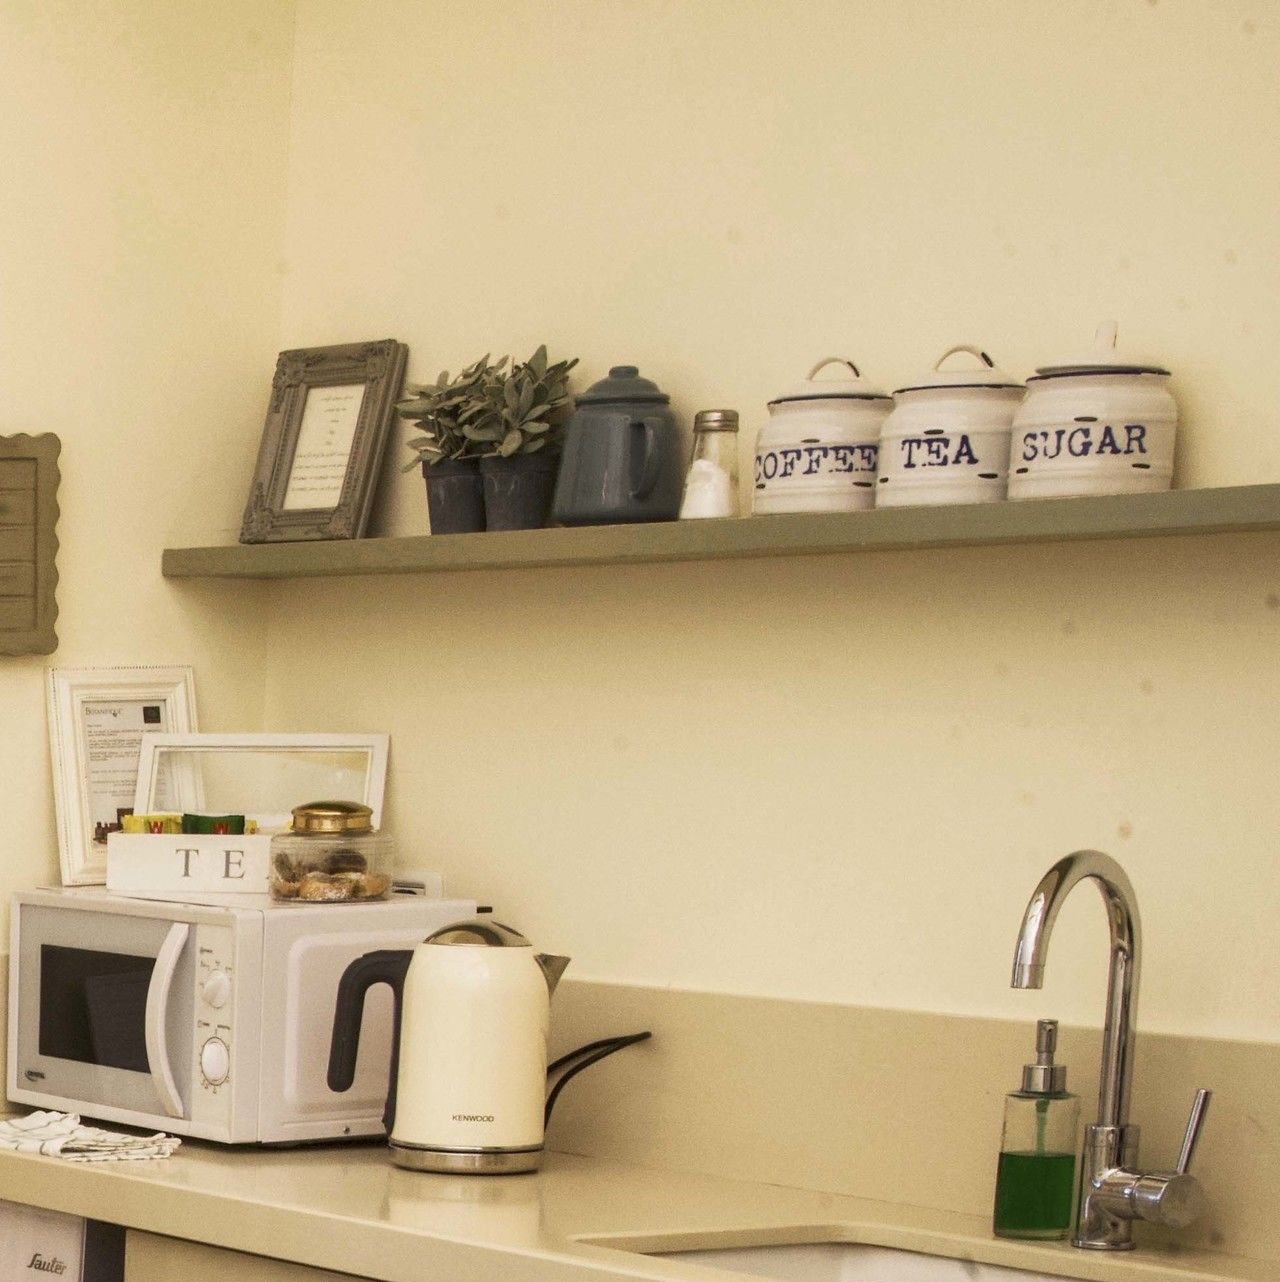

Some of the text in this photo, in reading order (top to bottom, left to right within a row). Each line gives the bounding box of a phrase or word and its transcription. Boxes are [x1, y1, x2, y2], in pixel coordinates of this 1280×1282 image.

[901, 434, 979, 469] TEA
[1023, 425, 1148, 462] SUGAR
[175, 848, 270, 880] TE
[451, 1114, 495, 1122] KENWOOD
[27, 1253, 67, 1275] Sauter
